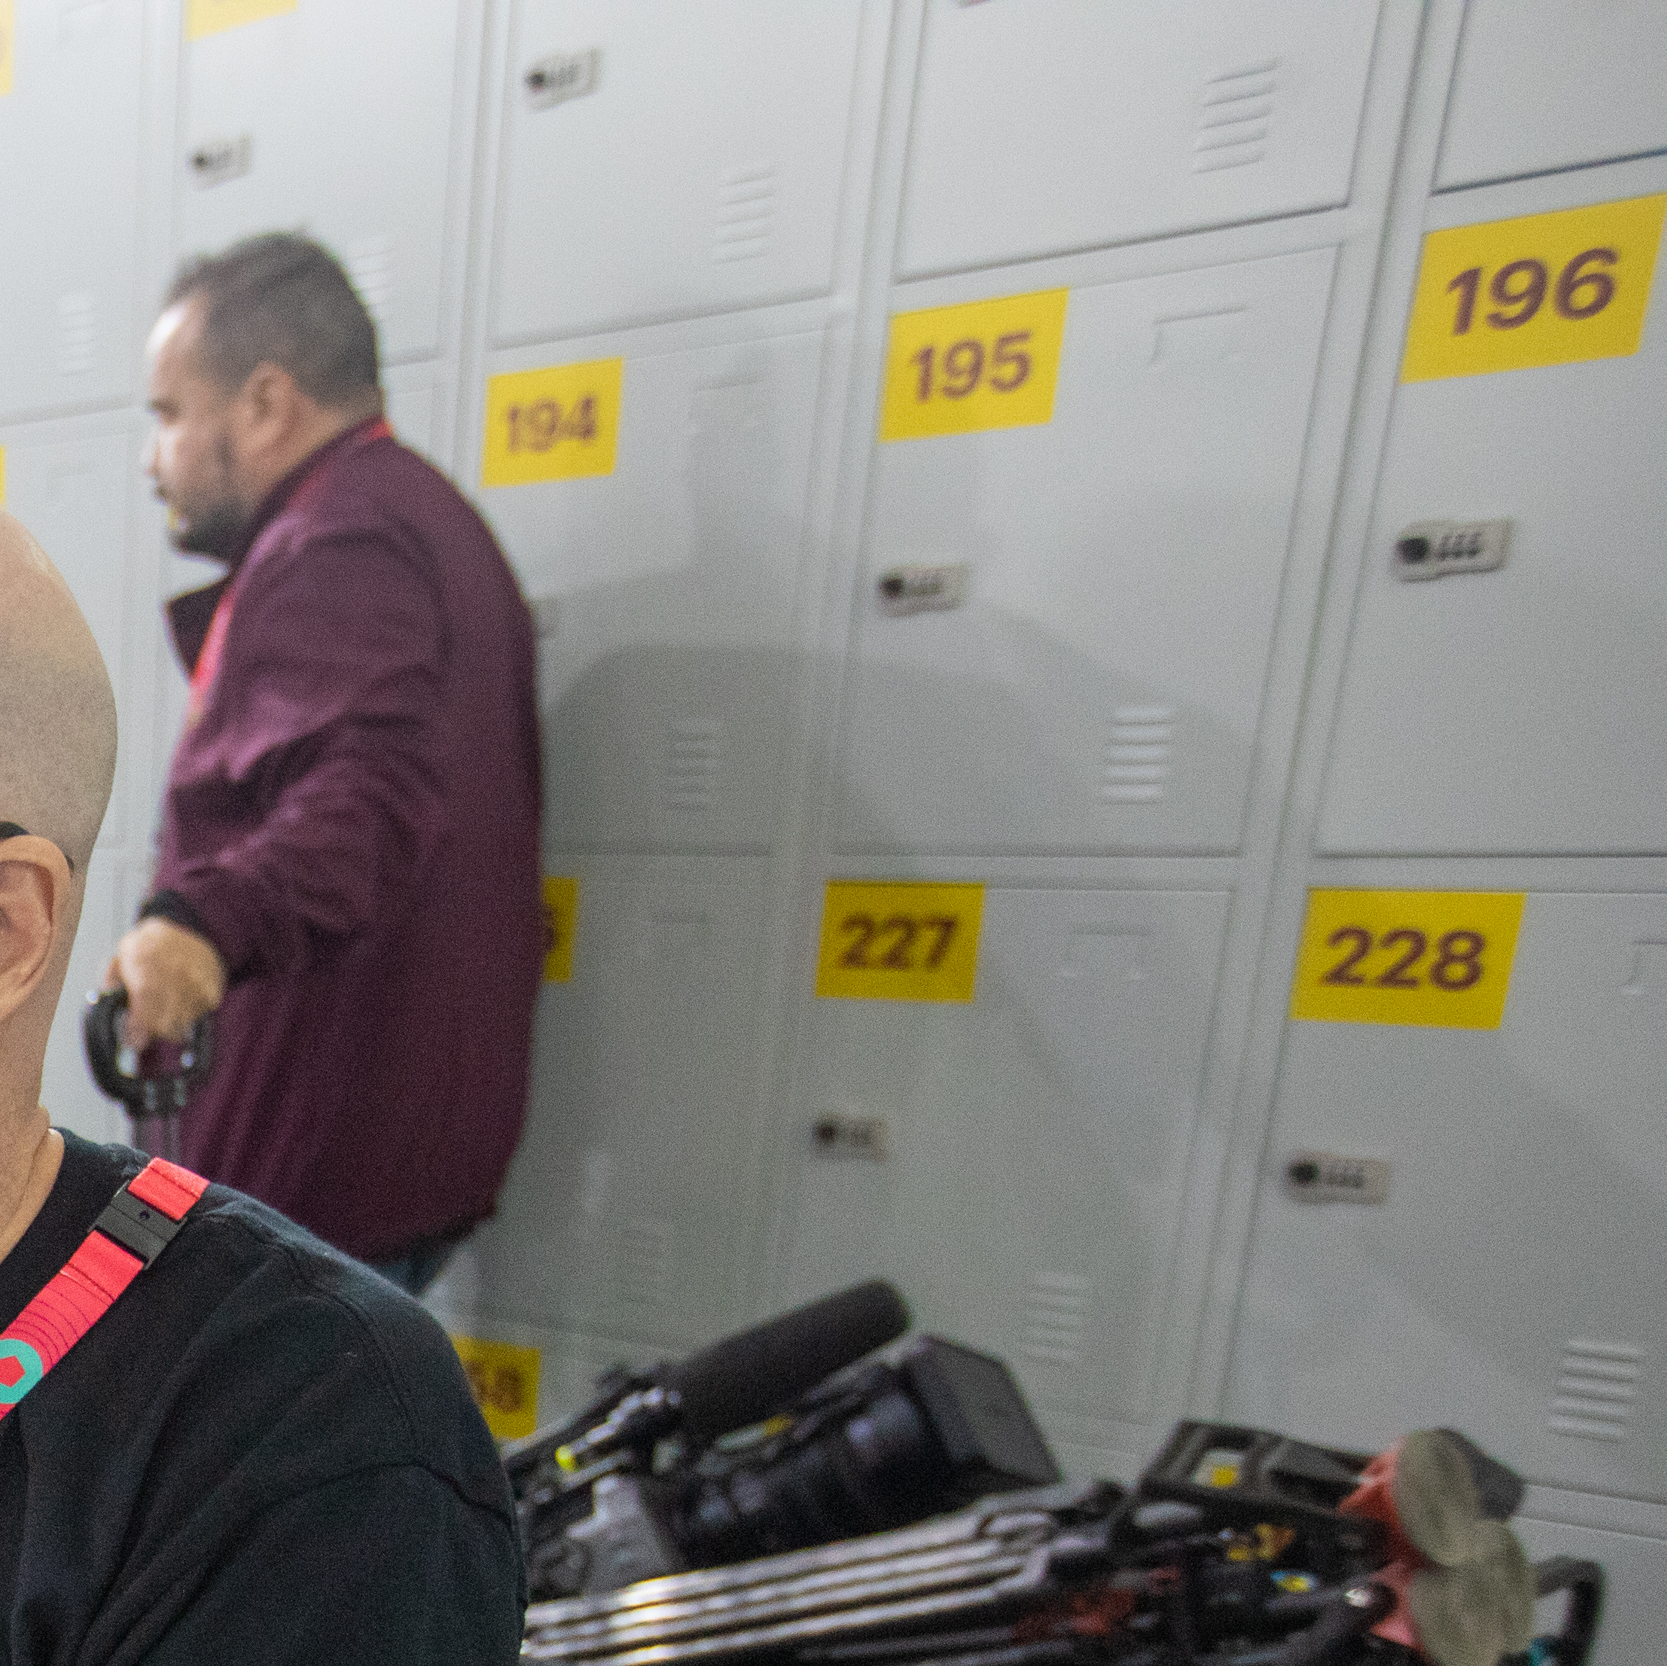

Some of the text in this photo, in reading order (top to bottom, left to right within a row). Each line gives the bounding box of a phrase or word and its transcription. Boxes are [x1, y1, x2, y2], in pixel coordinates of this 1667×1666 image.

[1446, 245, 1619, 337] 196
[908, 328, 1034, 403] 195
[505, 392, 598, 456] 194
[835, 912, 959, 971] 227
[1320, 926, 1487, 991] 228
